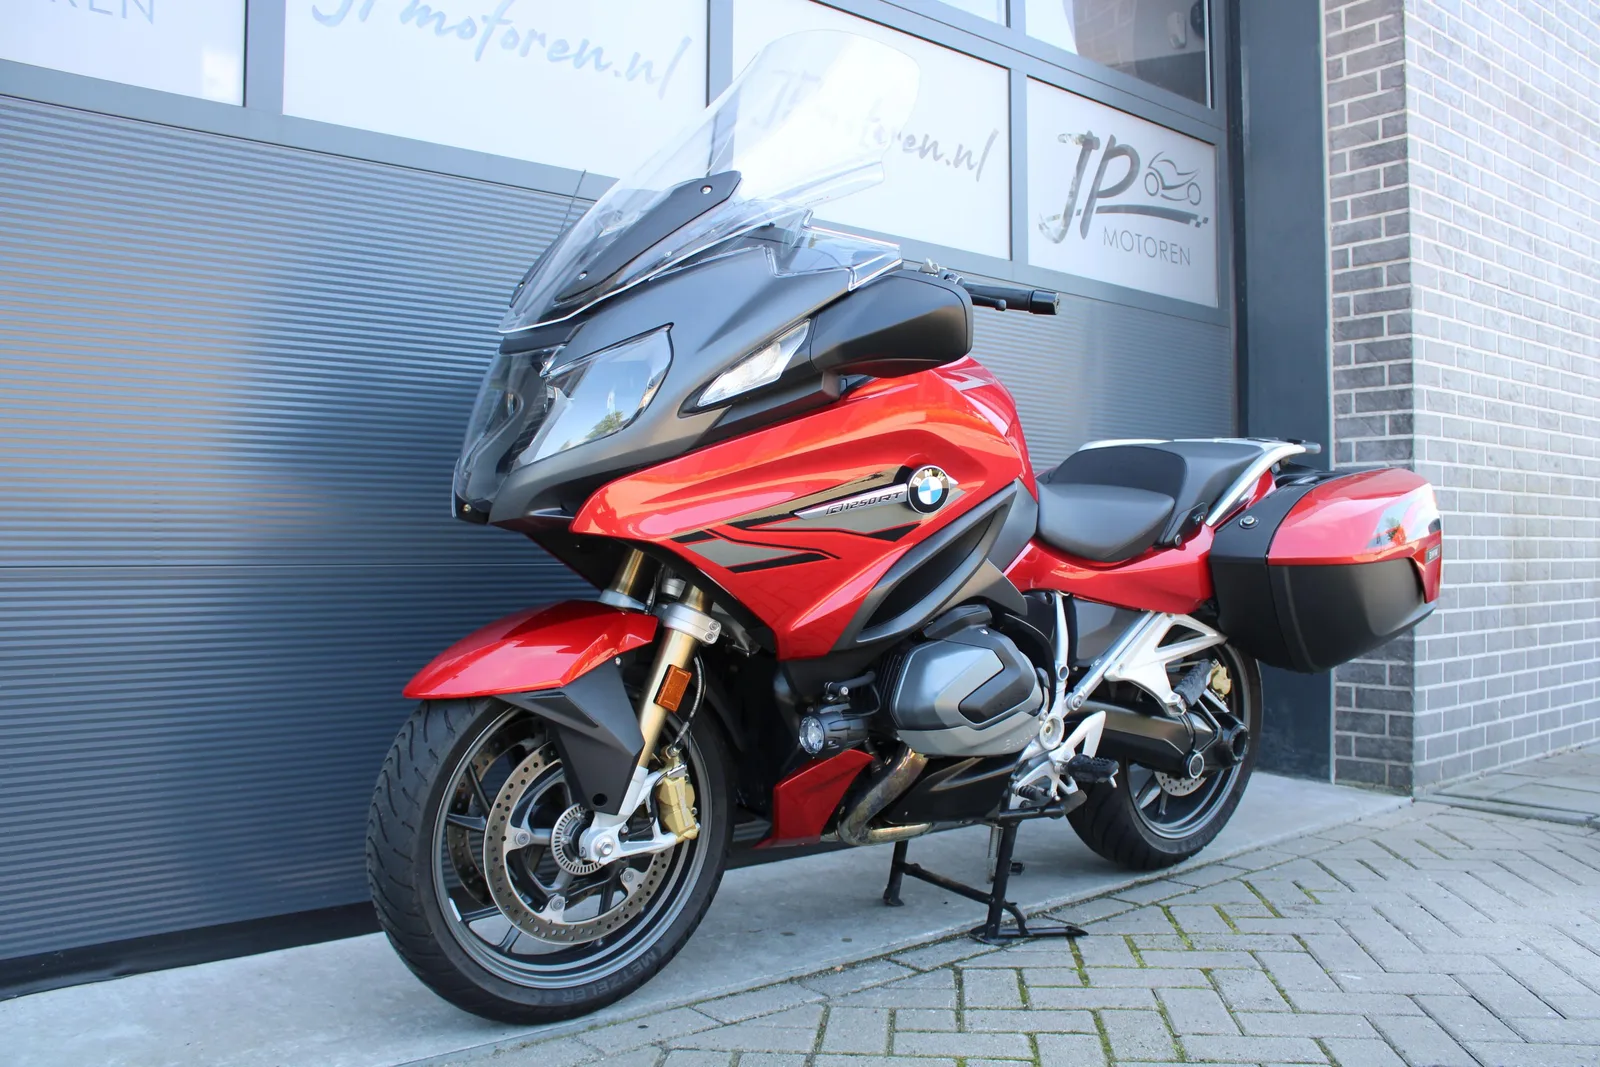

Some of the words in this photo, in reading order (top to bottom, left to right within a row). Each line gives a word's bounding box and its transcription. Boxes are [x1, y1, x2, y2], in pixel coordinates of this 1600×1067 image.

[1038, 130, 1141, 244] JP
[1103, 226, 1191, 266] MOTOREN
[912, 468, 946, 487] BMW
[562, 951, 659, 1002] METZELER
